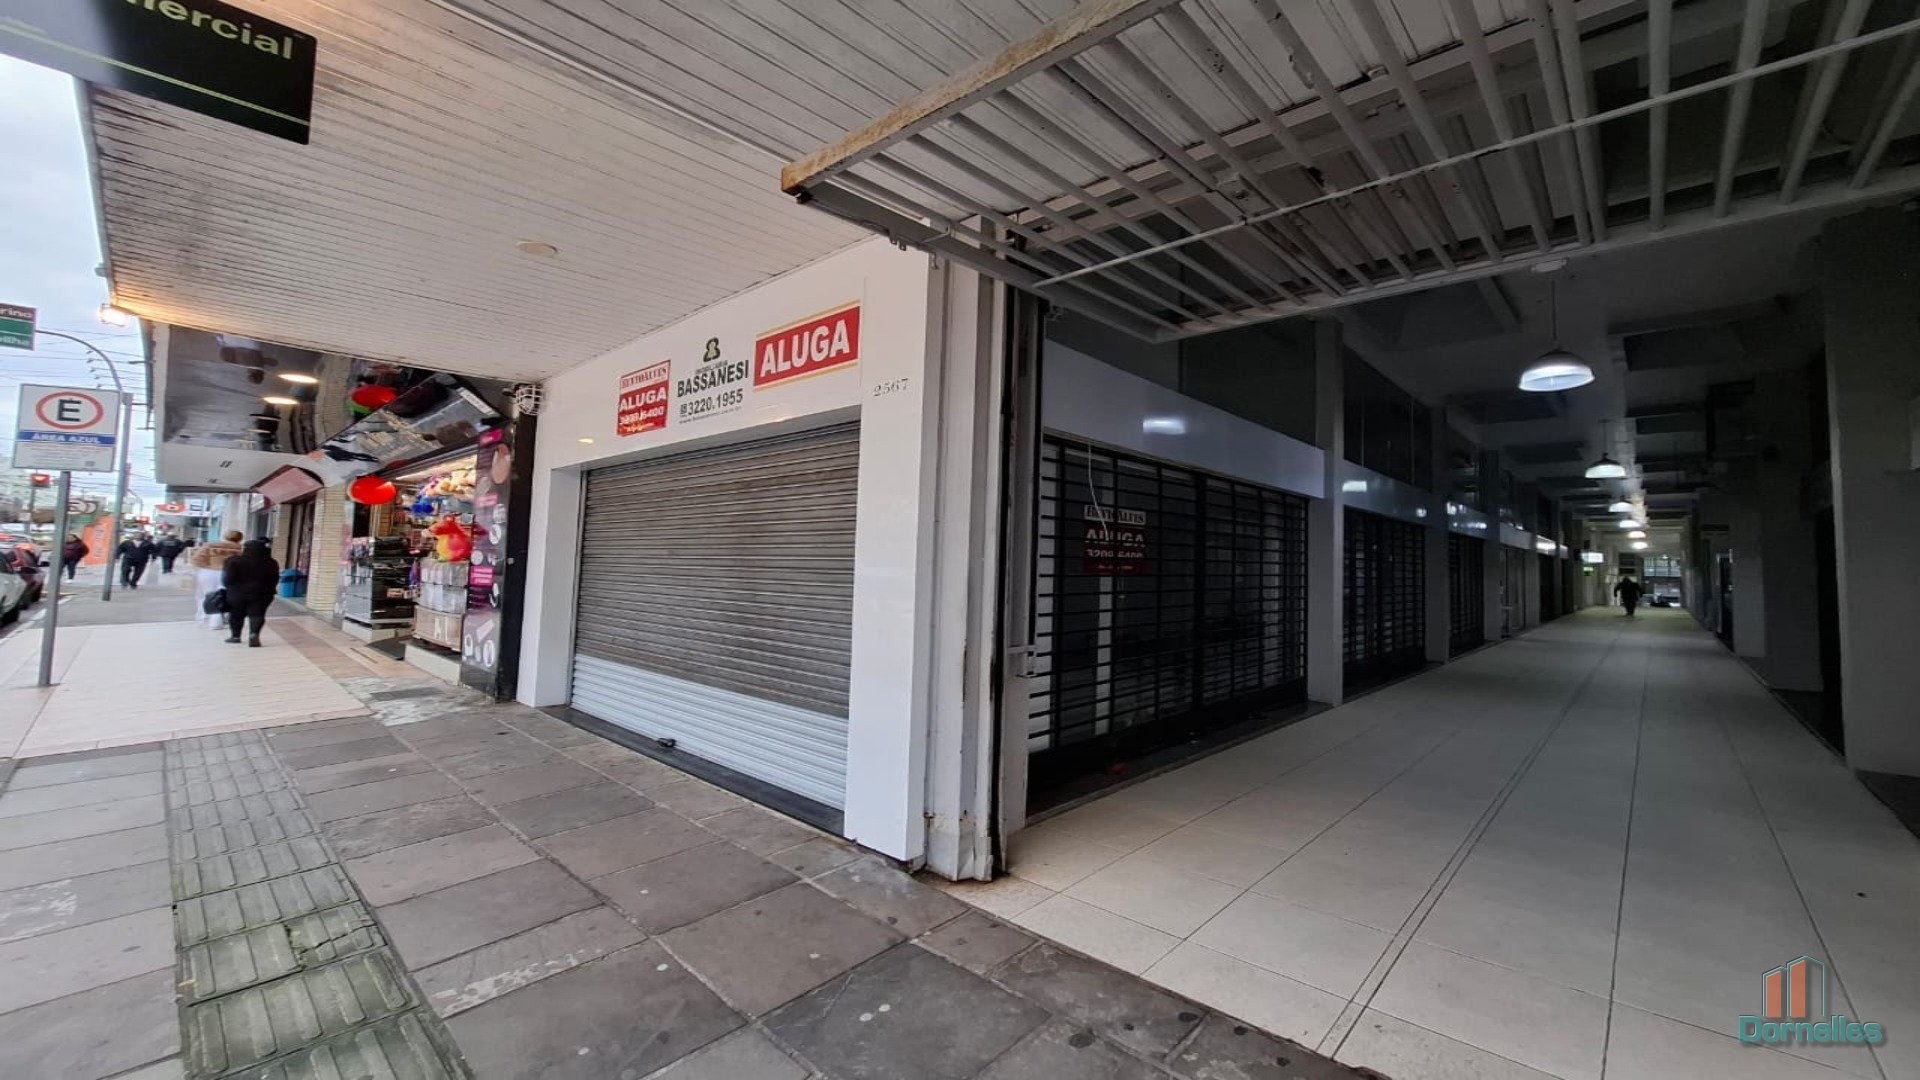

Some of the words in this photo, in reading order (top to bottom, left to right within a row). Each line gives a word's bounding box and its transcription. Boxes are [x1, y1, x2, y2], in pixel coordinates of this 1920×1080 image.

[126, 0, 293, 59] ercial
[760, 319, 850, 377] ALUGA
[677, 359, 749, 397] BASSANESI
[873, 377, 909, 397] 2567
[57, 398, 82, 422] E
[619, 386, 667, 412] ALUGA
[688, 388, 744, 415] 3220.1955
